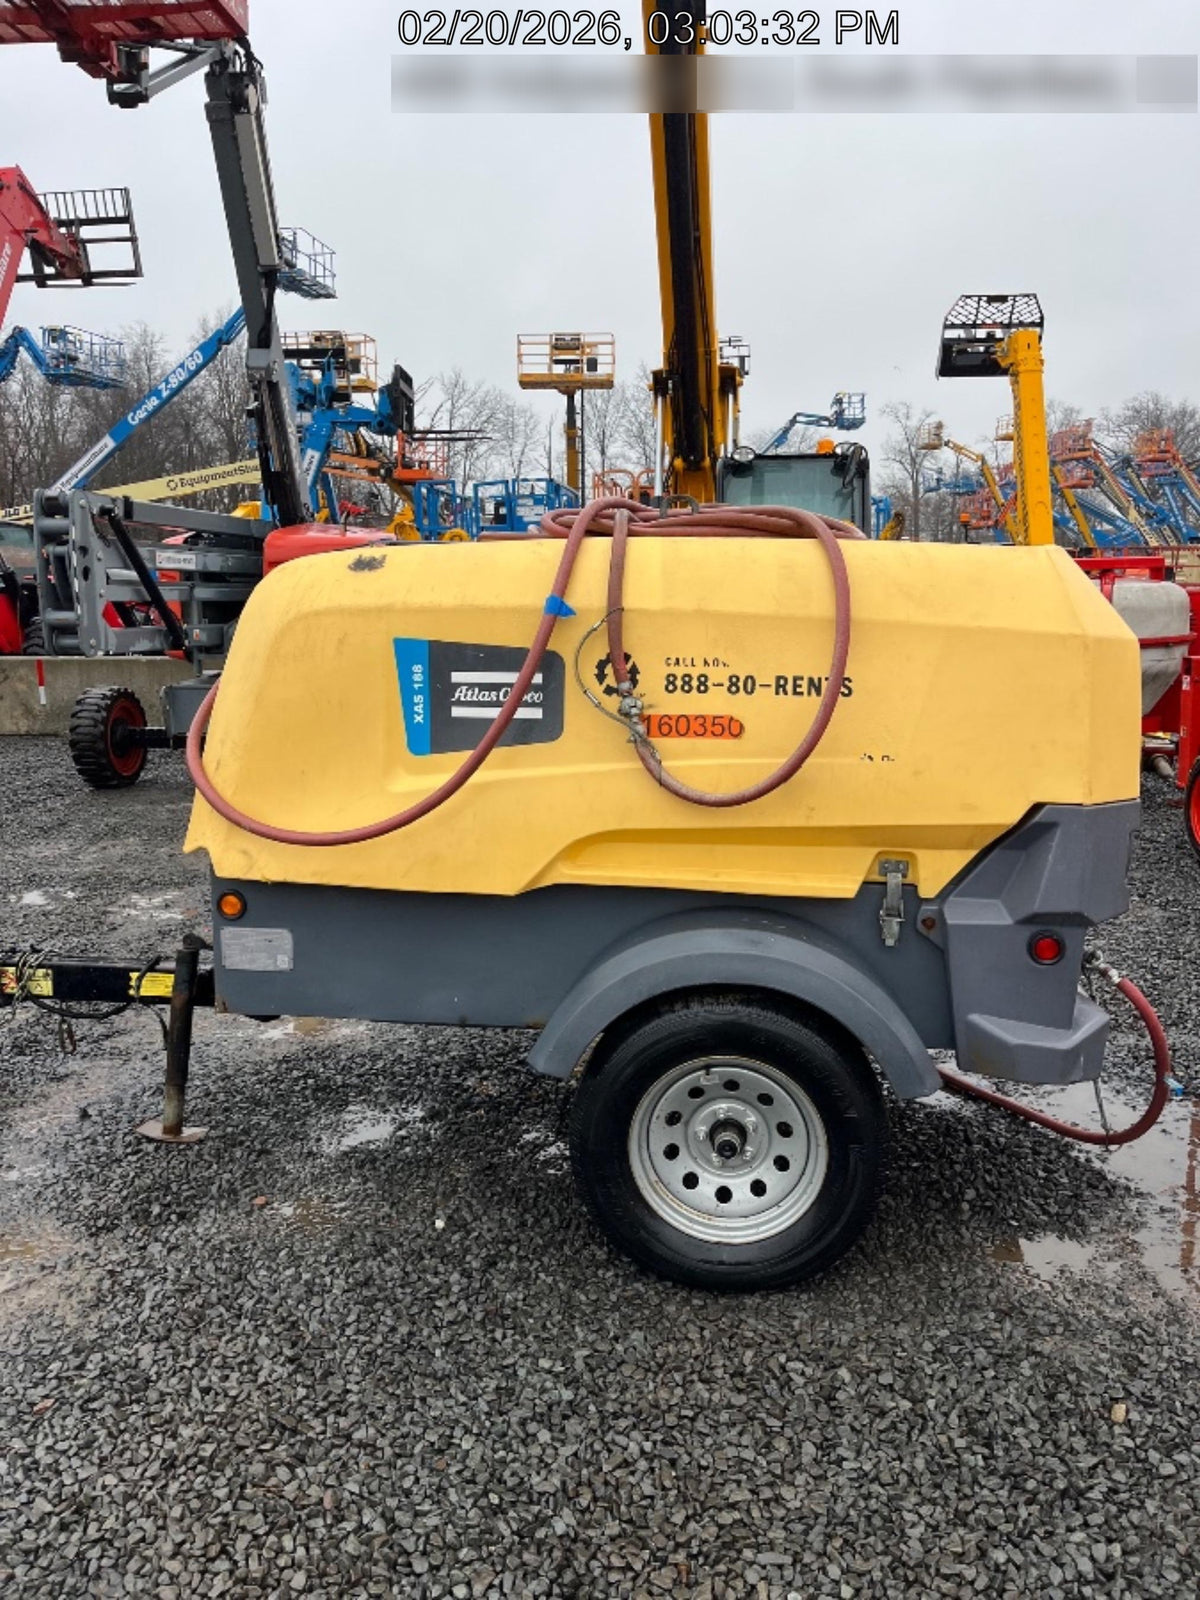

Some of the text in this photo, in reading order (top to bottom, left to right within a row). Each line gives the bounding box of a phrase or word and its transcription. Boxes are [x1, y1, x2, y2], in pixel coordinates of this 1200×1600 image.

[412, 664, 425, 724] XAS 188
[451, 685, 543, 703] Atlas Cco
[664, 673, 854, 698] 888-80-RENS
[643, 714, 744, 739] 160350
